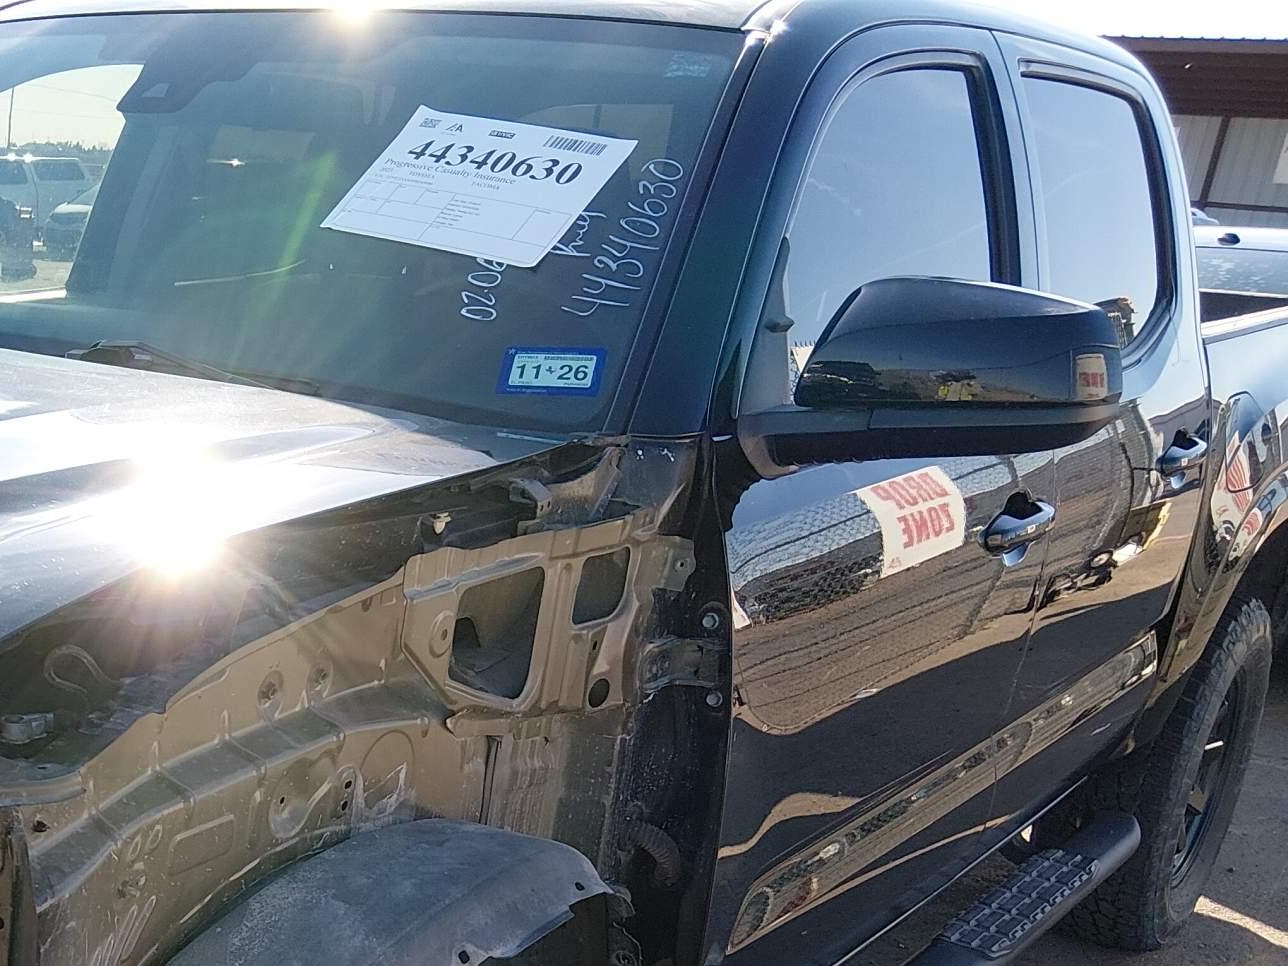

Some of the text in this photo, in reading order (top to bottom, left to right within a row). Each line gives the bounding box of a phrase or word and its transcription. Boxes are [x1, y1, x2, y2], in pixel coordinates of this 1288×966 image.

[408, 140, 583, 185] 44340630
[435, 166, 470, 178] Casualty
[473, 171, 517, 184] Insurance
[561, 158, 684, 316] 44340630
[516, 363, 589, 381] 11 26
